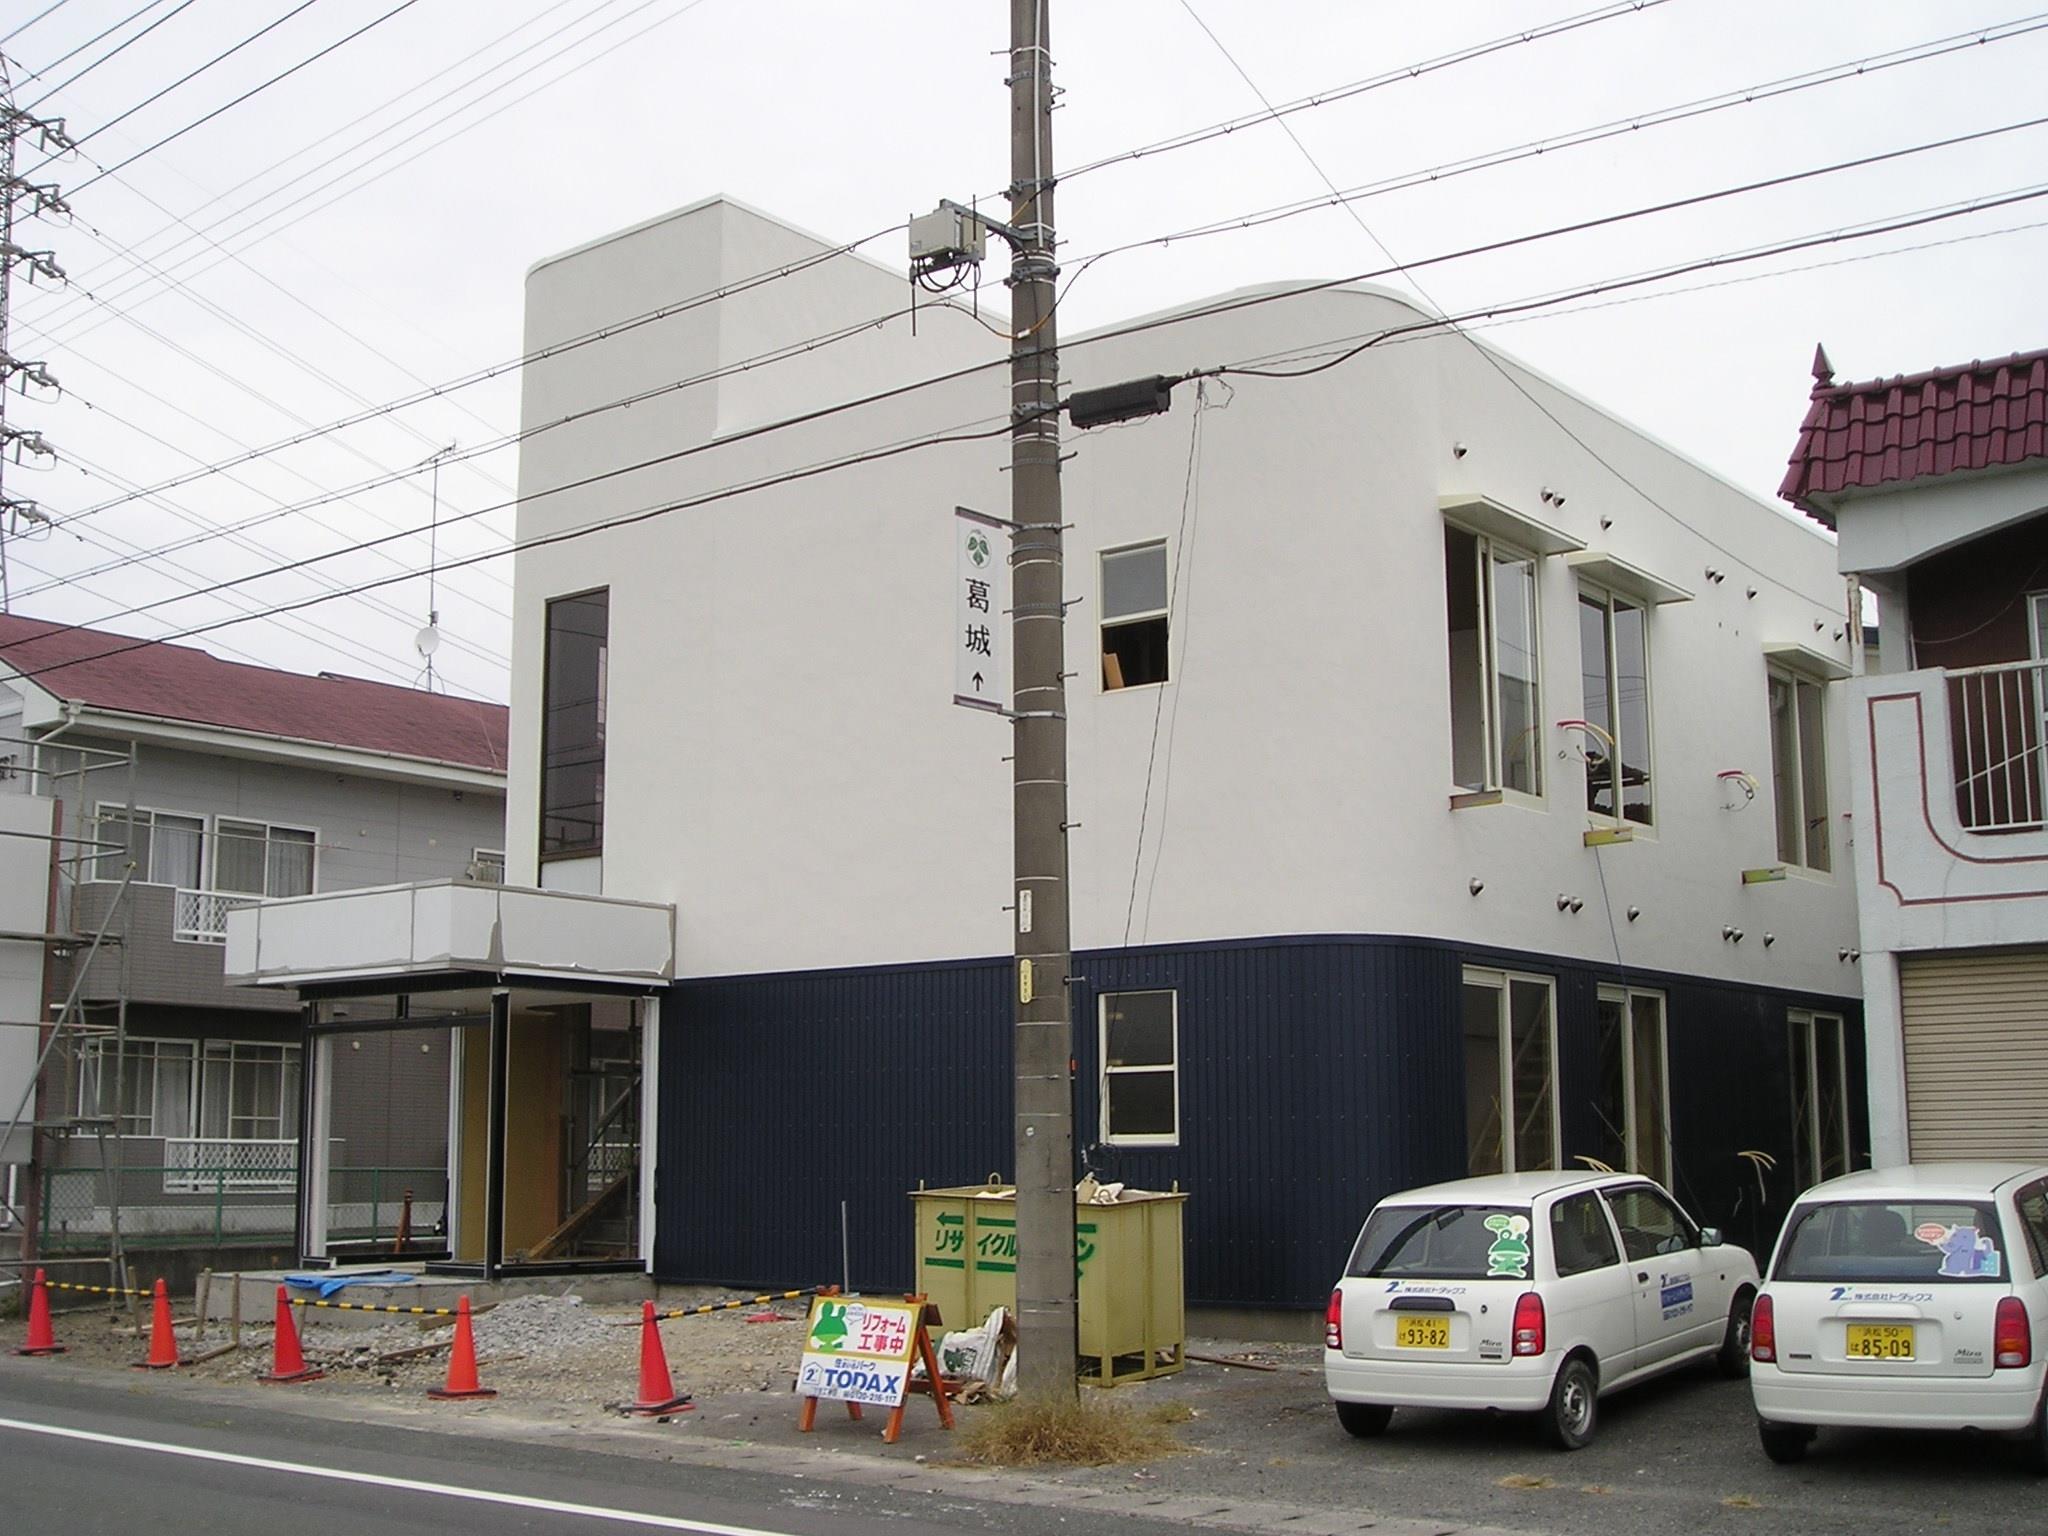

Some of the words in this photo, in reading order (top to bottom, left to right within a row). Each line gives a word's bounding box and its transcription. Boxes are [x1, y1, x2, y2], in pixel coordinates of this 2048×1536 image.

[965, 577, 992, 657] 葛城
[1854, 1292, 1934, 1301] 株式会社トダックス
[862, 1313, 906, 1334] リフォーム
[1883, 1327, 1899, 1337] 50
[857, 1333, 905, 1355] 工事中
[1407, 1329, 1447, 1345] 93-82
[1861, 1339, 1911, 1357] 85-09
[824, 1368, 902, 1395] TODAX
